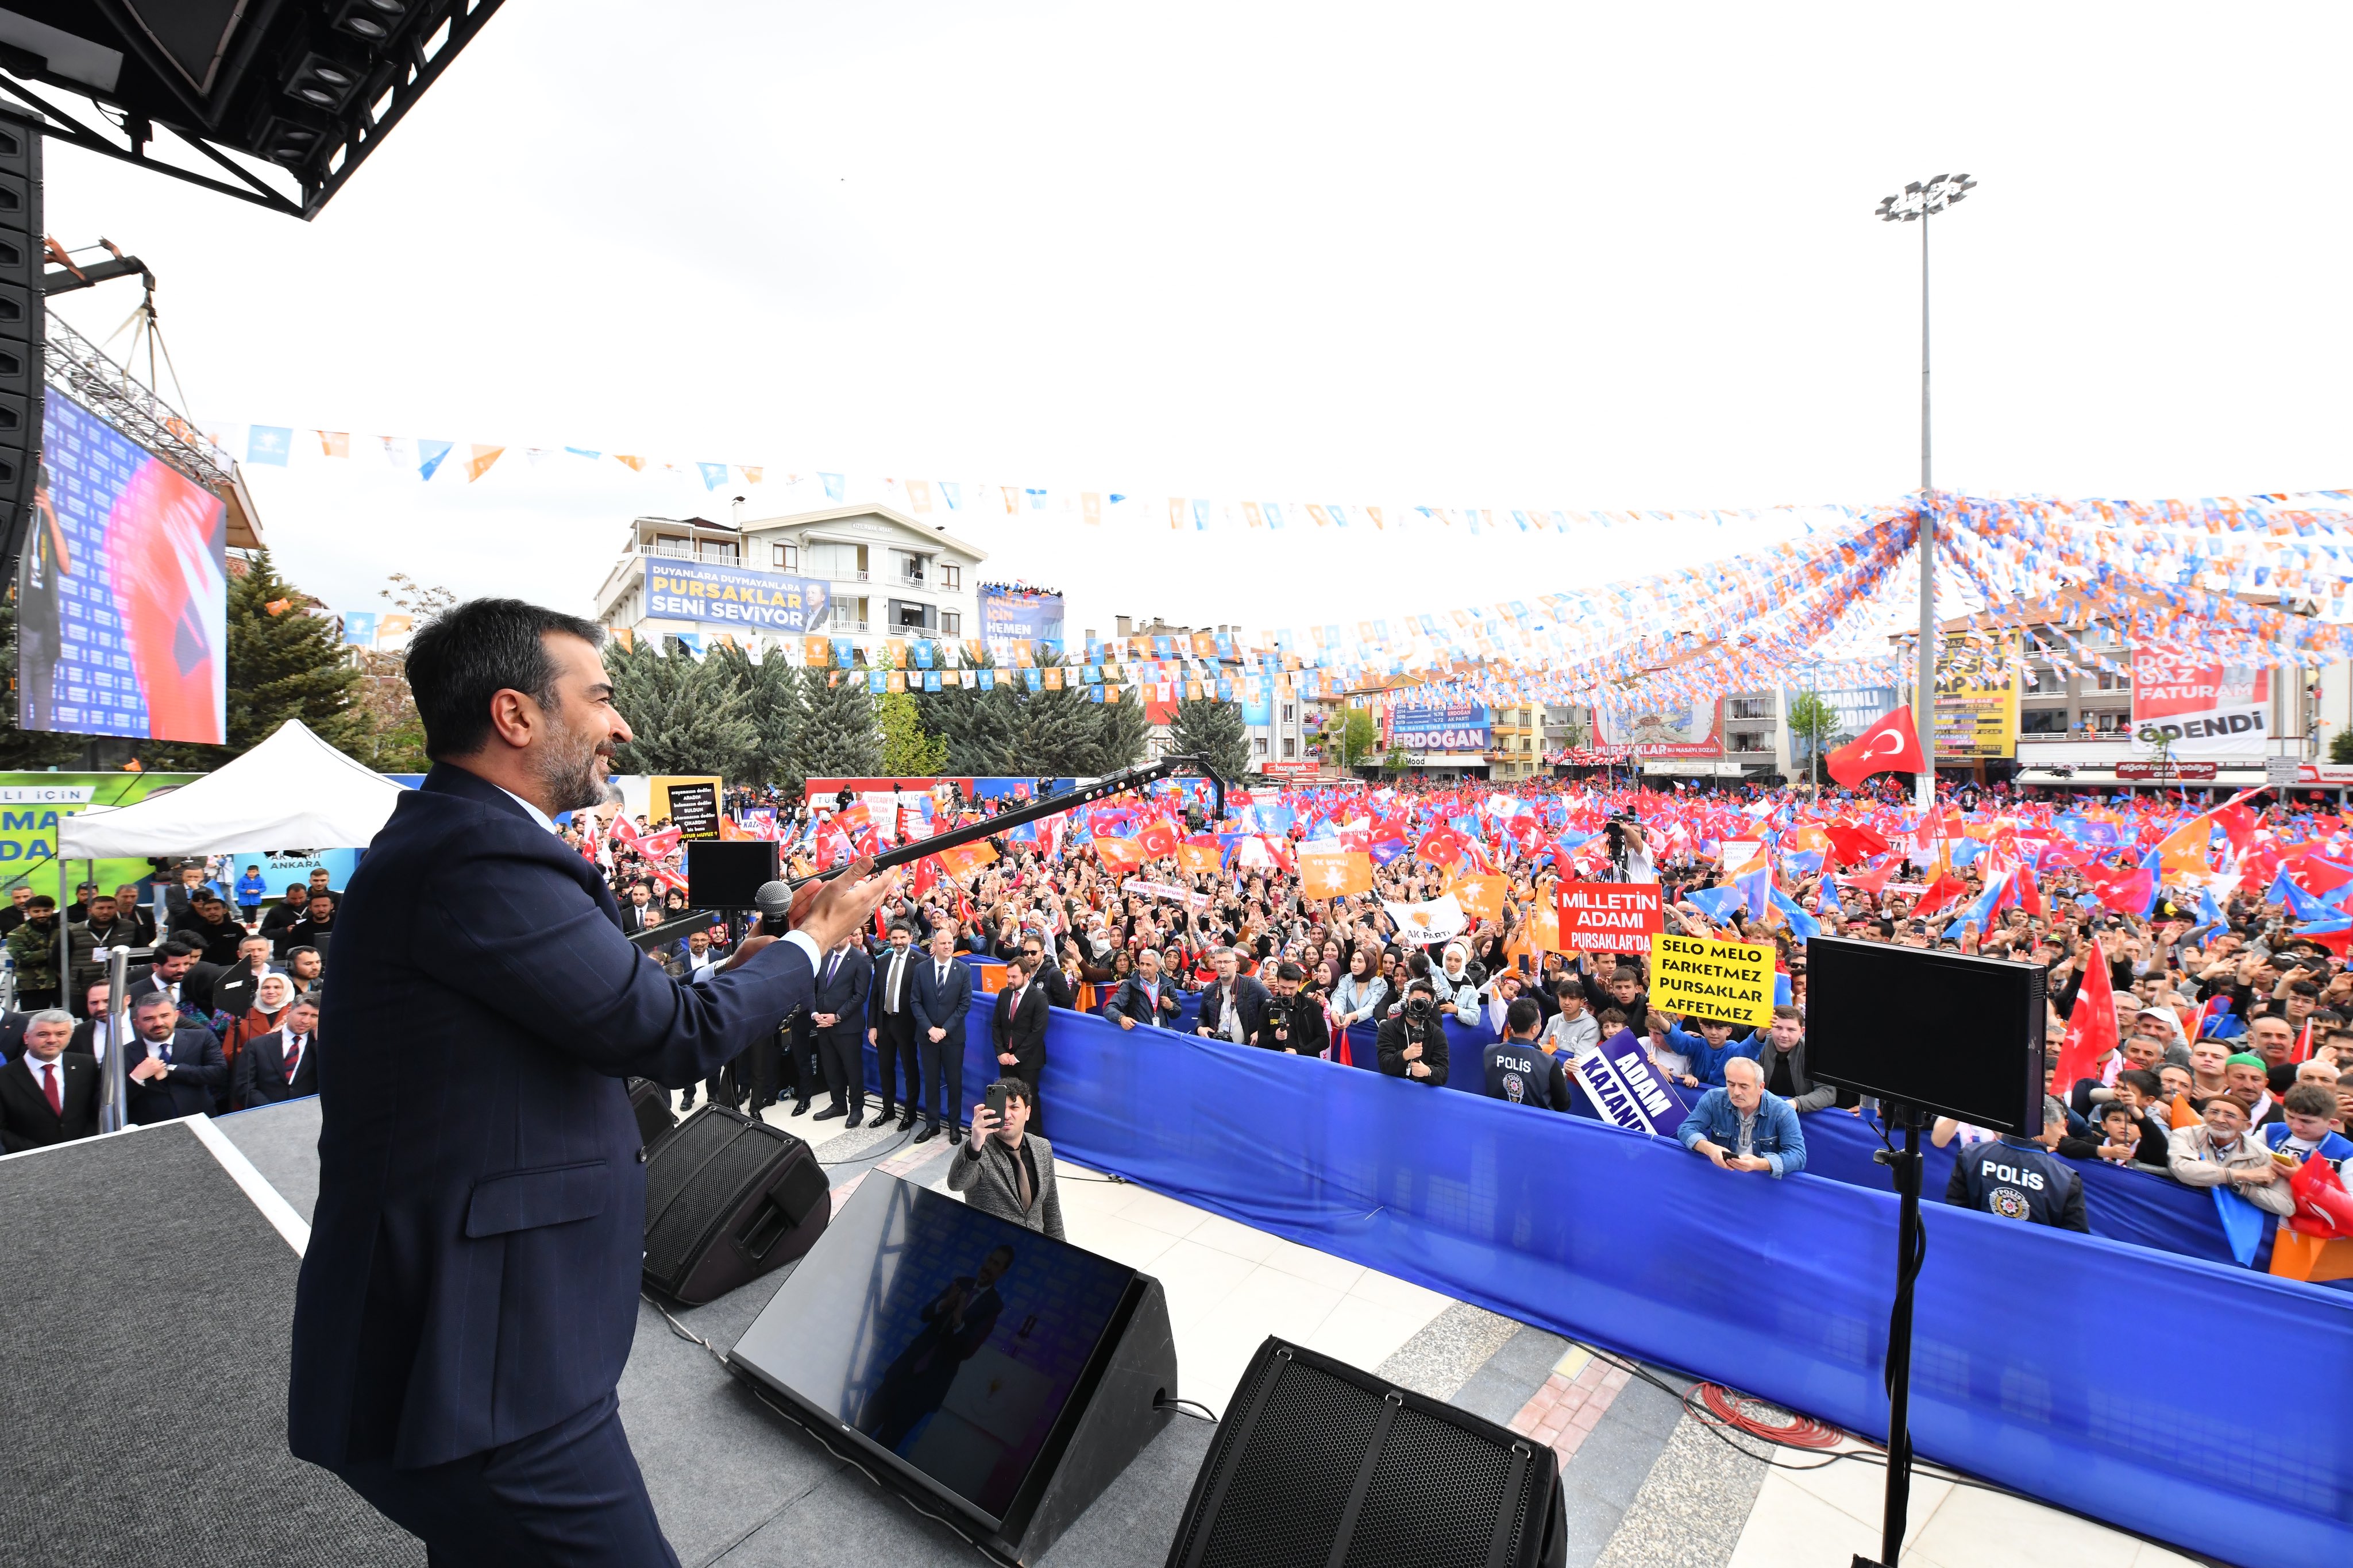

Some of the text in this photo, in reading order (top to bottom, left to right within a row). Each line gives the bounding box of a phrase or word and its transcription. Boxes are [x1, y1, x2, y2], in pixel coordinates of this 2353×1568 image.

[653, 566, 801, 592] DUYANLARA DUYMAYANLARA
[653, 576, 802, 609] PURSAKLAR
[987, 596, 1040, 608] ANKARA
[651, 595, 803, 627] SENİ SEVİYOR
[986, 621, 1031, 635] HEMEN
[1818, 691, 1879, 709] SMANLI
[2139, 682, 2254, 700] FATURAM
[2138, 710, 2265, 743] ÖDENDİ
[1394, 729, 1484, 748] ERDOĞAN
[1595, 744, 1667, 755] PURSAKLAR
[867, 795, 894, 804] SECCADEYE
[3, 811, 75, 830] MA
[270, 861, 321, 869] ANKARA
[1139, 883, 1166, 893] GENLİK
[1563, 890, 1657, 910] MİLLETİN
[1576, 911, 1644, 929] ADAMI
[1407, 930, 1419, 939] AK
[1662, 940, 1762, 963] SELO MELO
[1662, 959, 1761, 983] FARKETMEZ
[1660, 977, 1762, 1003] PURSAKLAR
[1665, 998, 1753, 1021] AFFETMEZ
[1496, 1055, 1531, 1073] POLİS
[1580, 1056, 1646, 1132] KAZAND
[1614, 1052, 1672, 1118] ADAM
[1982, 1160, 2044, 1190] POLİS
